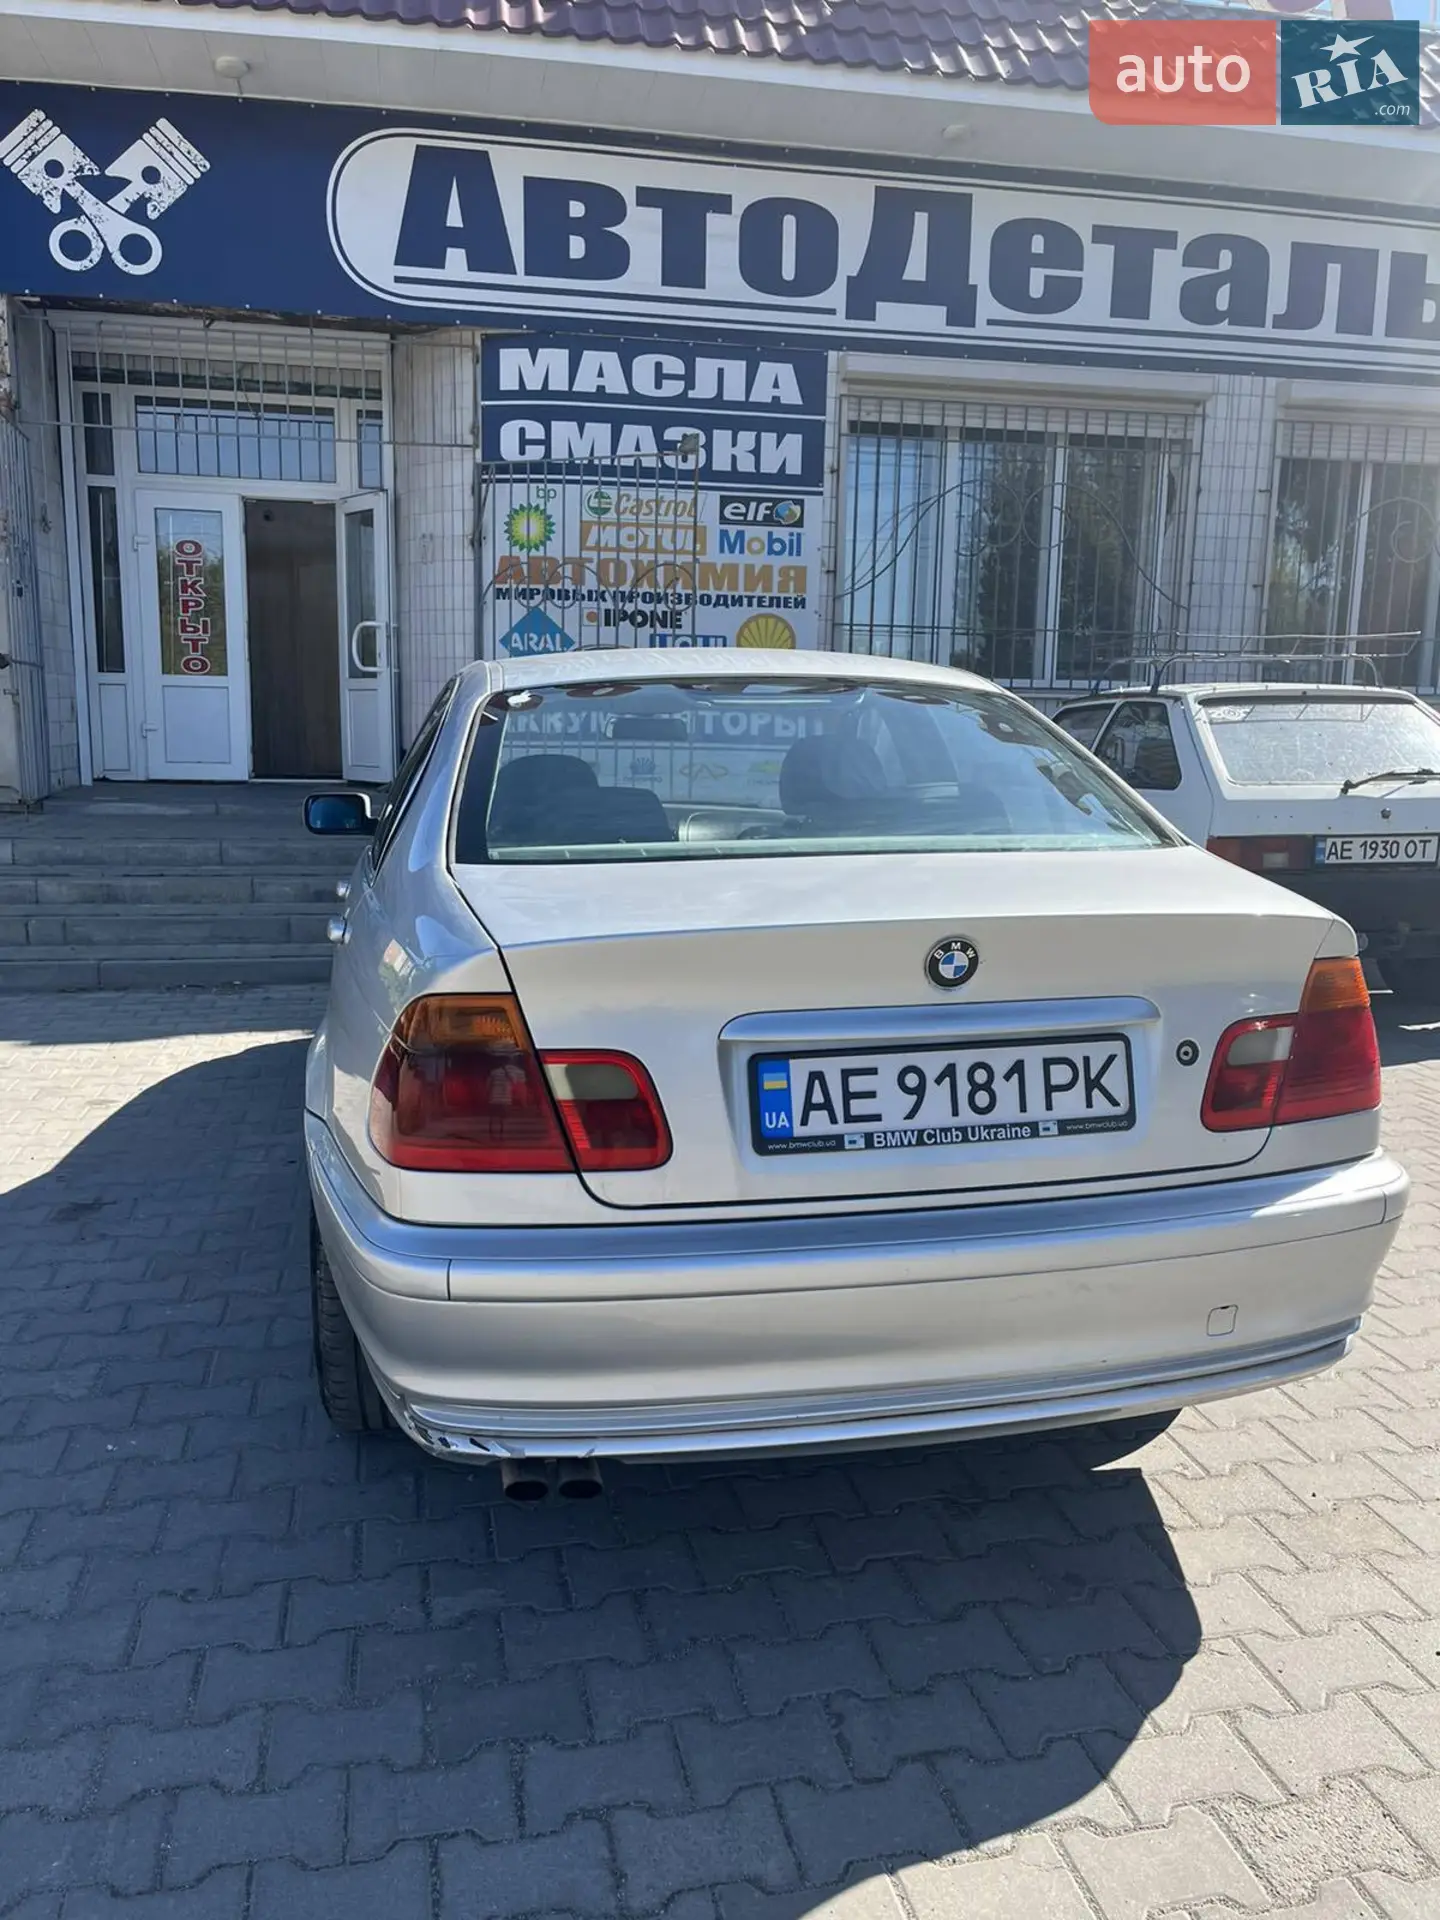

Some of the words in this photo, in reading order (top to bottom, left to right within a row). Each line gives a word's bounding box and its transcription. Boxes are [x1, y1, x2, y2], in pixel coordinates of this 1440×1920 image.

[499, 348, 804, 405] МАСЛА
[500, 419, 803, 476] СМАЗКИ
[536, 486, 557, 501] bp
[615, 492, 698, 517] Castrol
[723, 500, 774, 522] elf
[585, 523, 701, 551] MOTUL
[719, 529, 801, 557] Mobil
[495, 554, 807, 594] АВТОХИМИЯ
[174, 539, 211, 675] ОТКРЫТО
[496, 586, 608, 602] МИРОВЫХ
[612, 589, 806, 609] ПРОИЗВОДИТЕЛЕЙ
[604, 608, 683, 629] IPONE
[510, 631, 568, 652] ARAL
[1326, 841, 1353, 860] AE
[1359, 840, 1400, 860] 1930
[1404, 839, 1432, 859] OT
[933, 942, 976, 959] BMW
[799, 1066, 882, 1127] AE
[896, 1059, 1027, 1121] 9181
[1042, 1053, 1122, 1111] PK
[765, 1111, 790, 1129] UA
[873, 1131, 919, 1148] BMW
[923, 1127, 962, 1145] Club
[967, 1123, 1031, 1143] Ukraine
